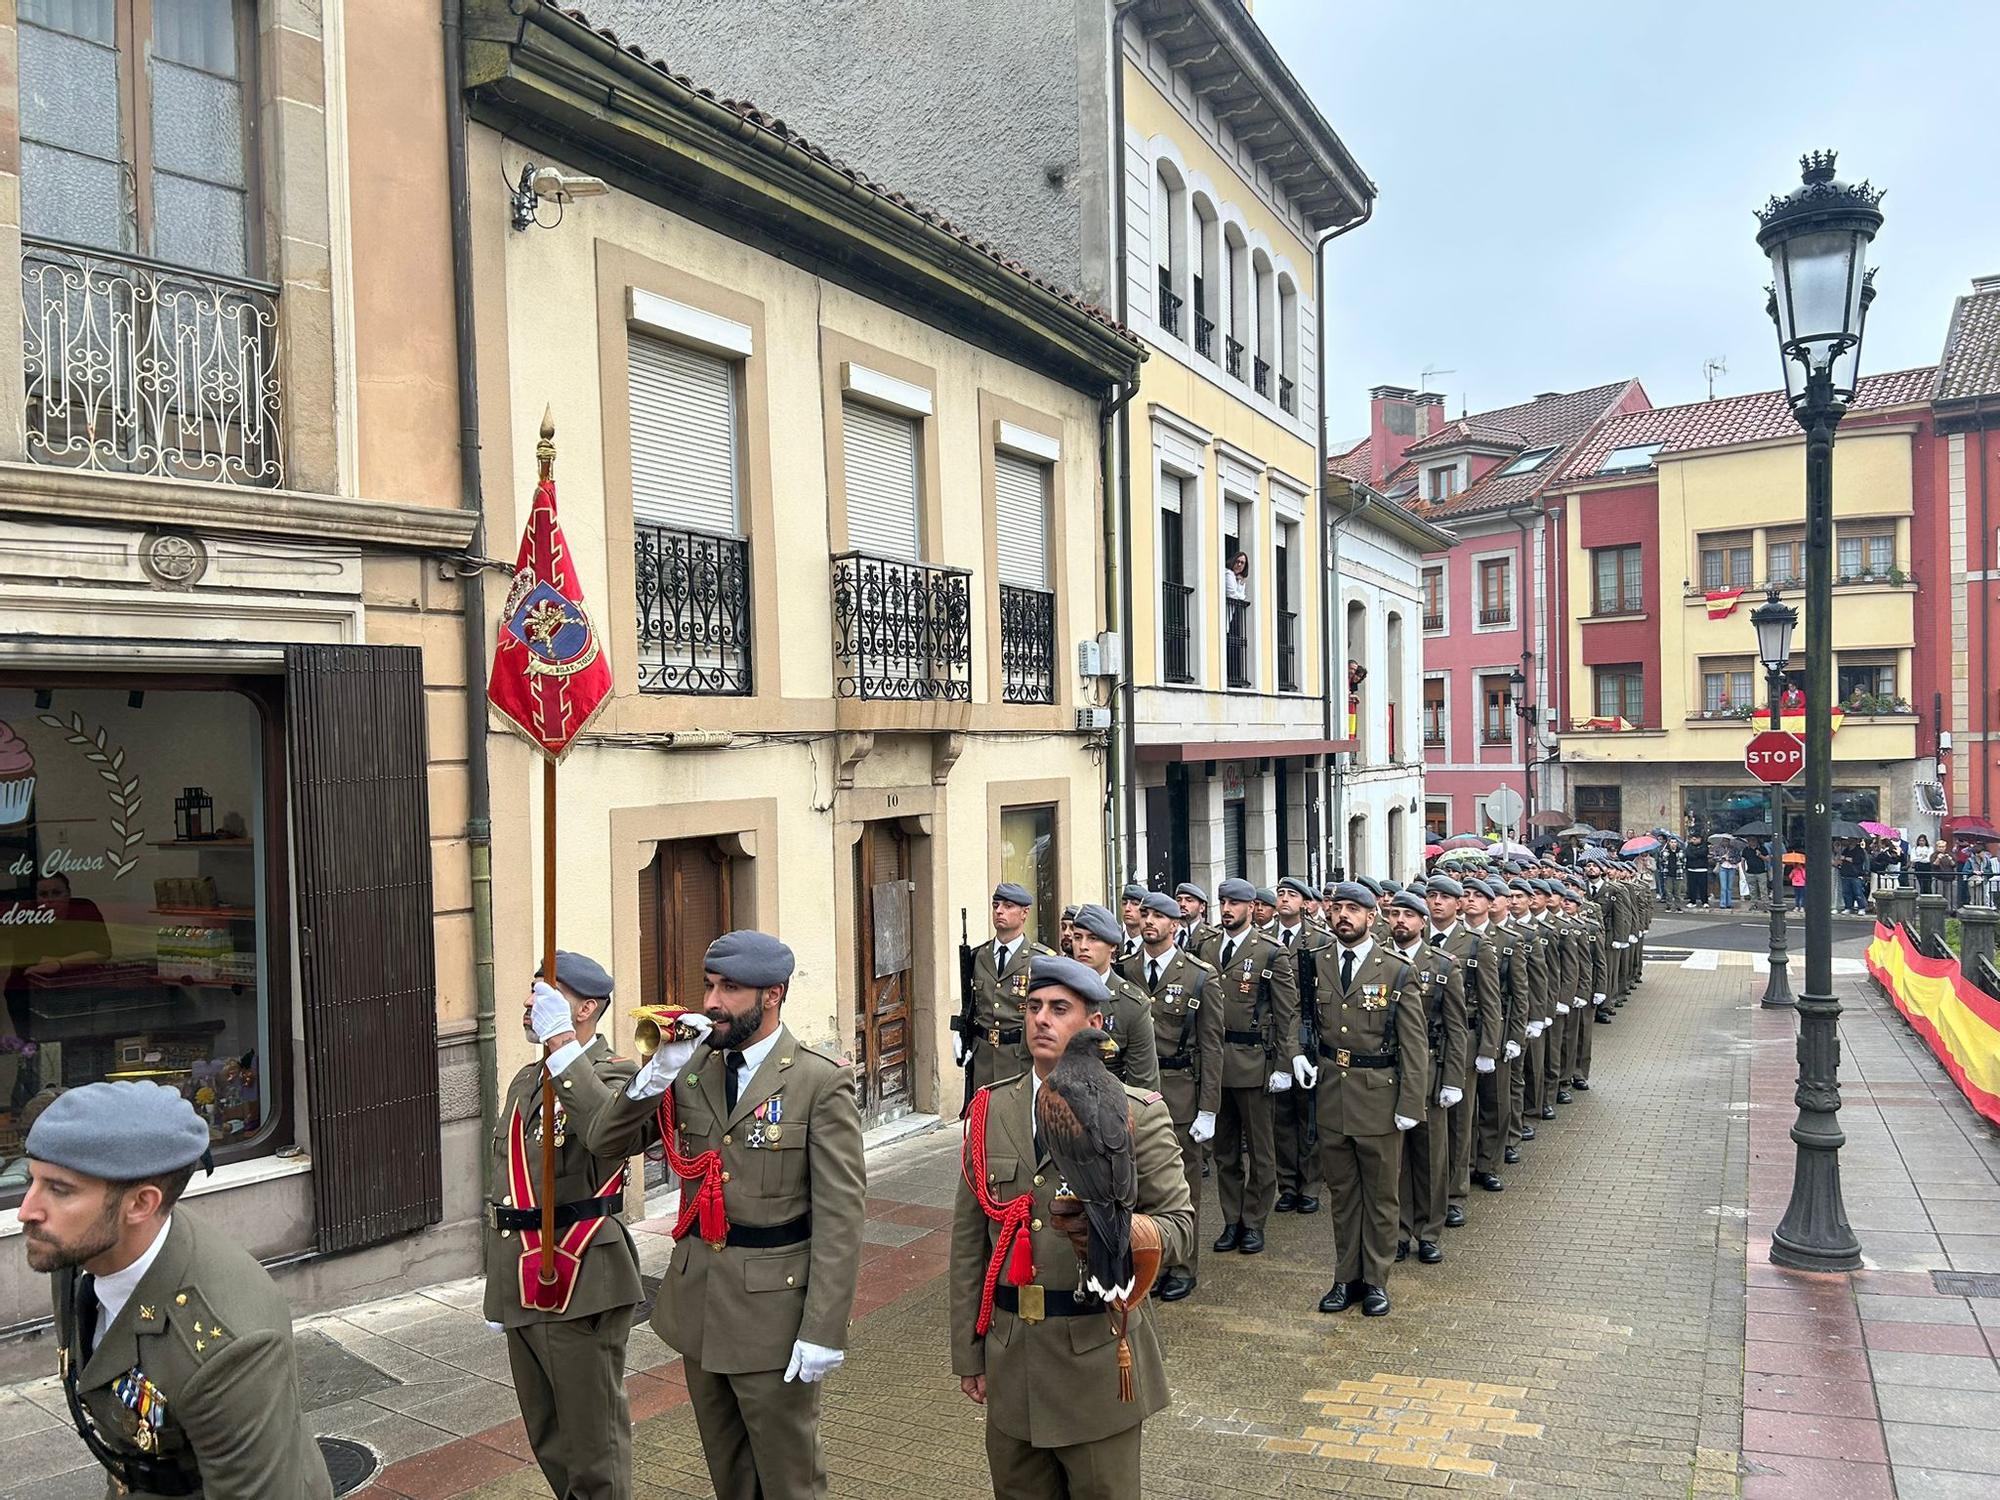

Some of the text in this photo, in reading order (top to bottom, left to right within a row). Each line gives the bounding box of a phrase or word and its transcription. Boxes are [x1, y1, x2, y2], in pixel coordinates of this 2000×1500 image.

[1748, 750, 1800, 763] STOP
[887, 794, 899, 807] 10
[1815, 803, 1825, 814] 9
[9, 848, 105, 878] de Chusa
[0, 902, 56, 925] dería
